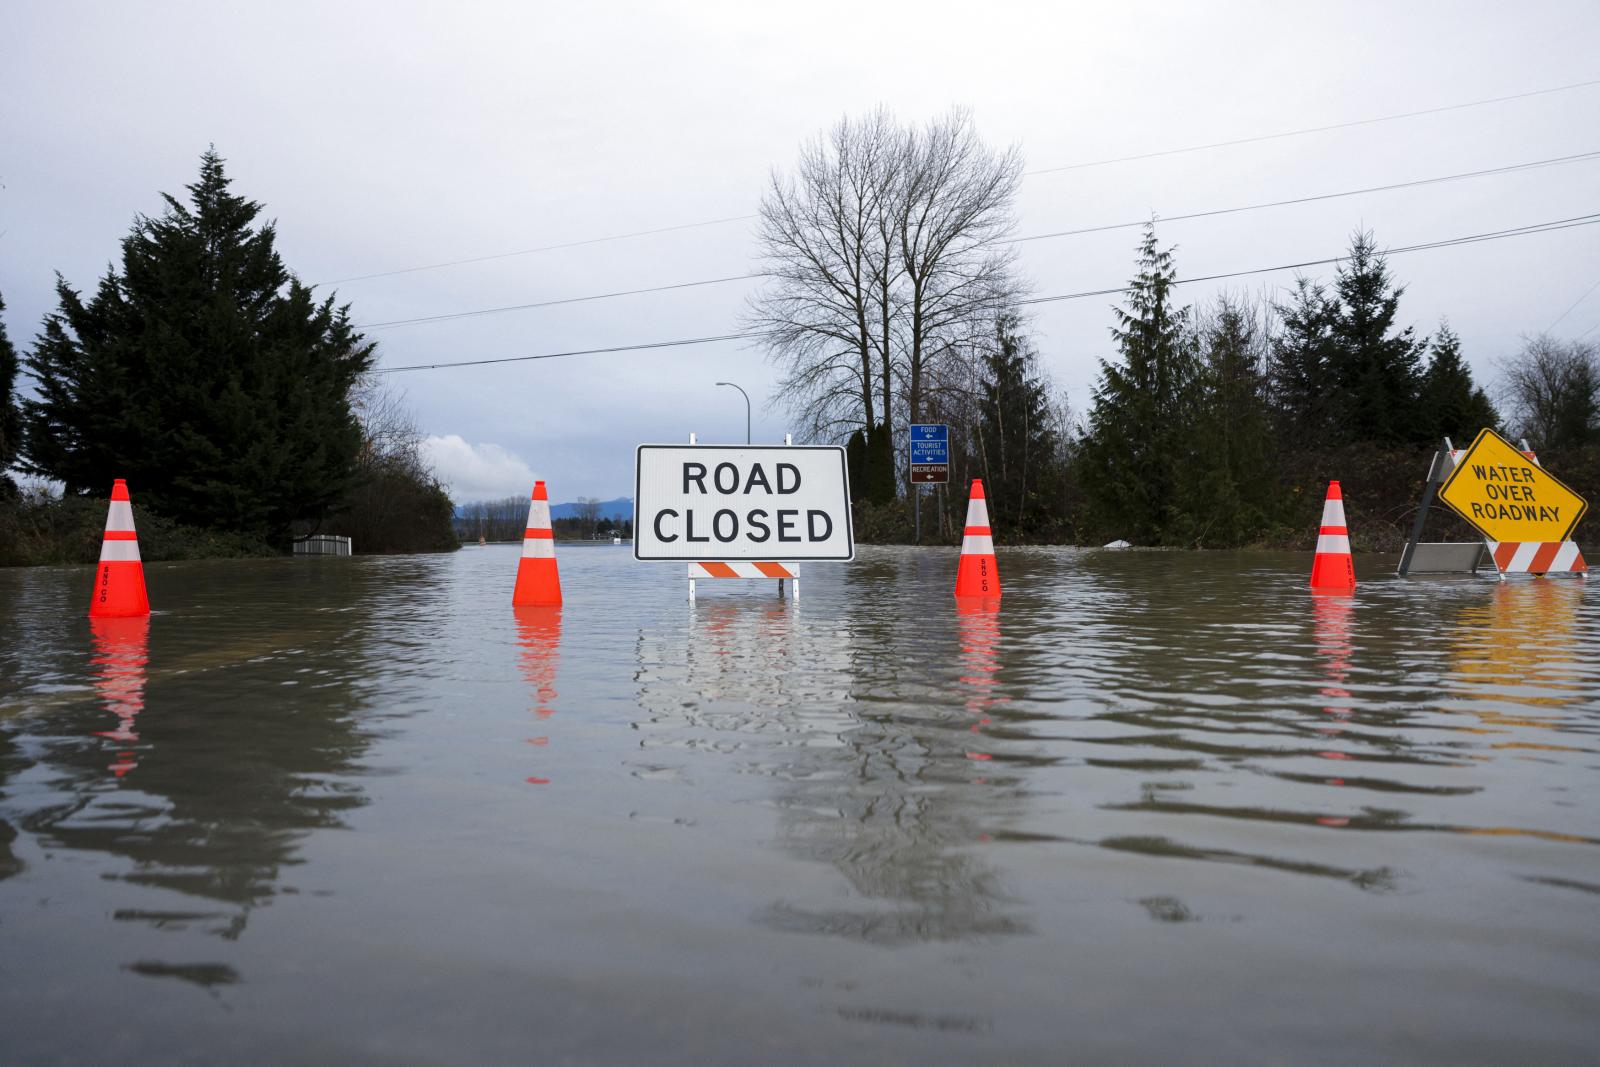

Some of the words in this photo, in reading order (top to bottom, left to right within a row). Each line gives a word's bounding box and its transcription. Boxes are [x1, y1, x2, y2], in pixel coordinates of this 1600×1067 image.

[683, 462, 802, 495] ROAD
[1472, 464, 1535, 483] WATER
[1486, 484, 1536, 502] OVER
[1472, 502, 1560, 522] ROADWAY
[654, 508, 833, 543] CLOSED
[982, 580, 988, 592] CO
